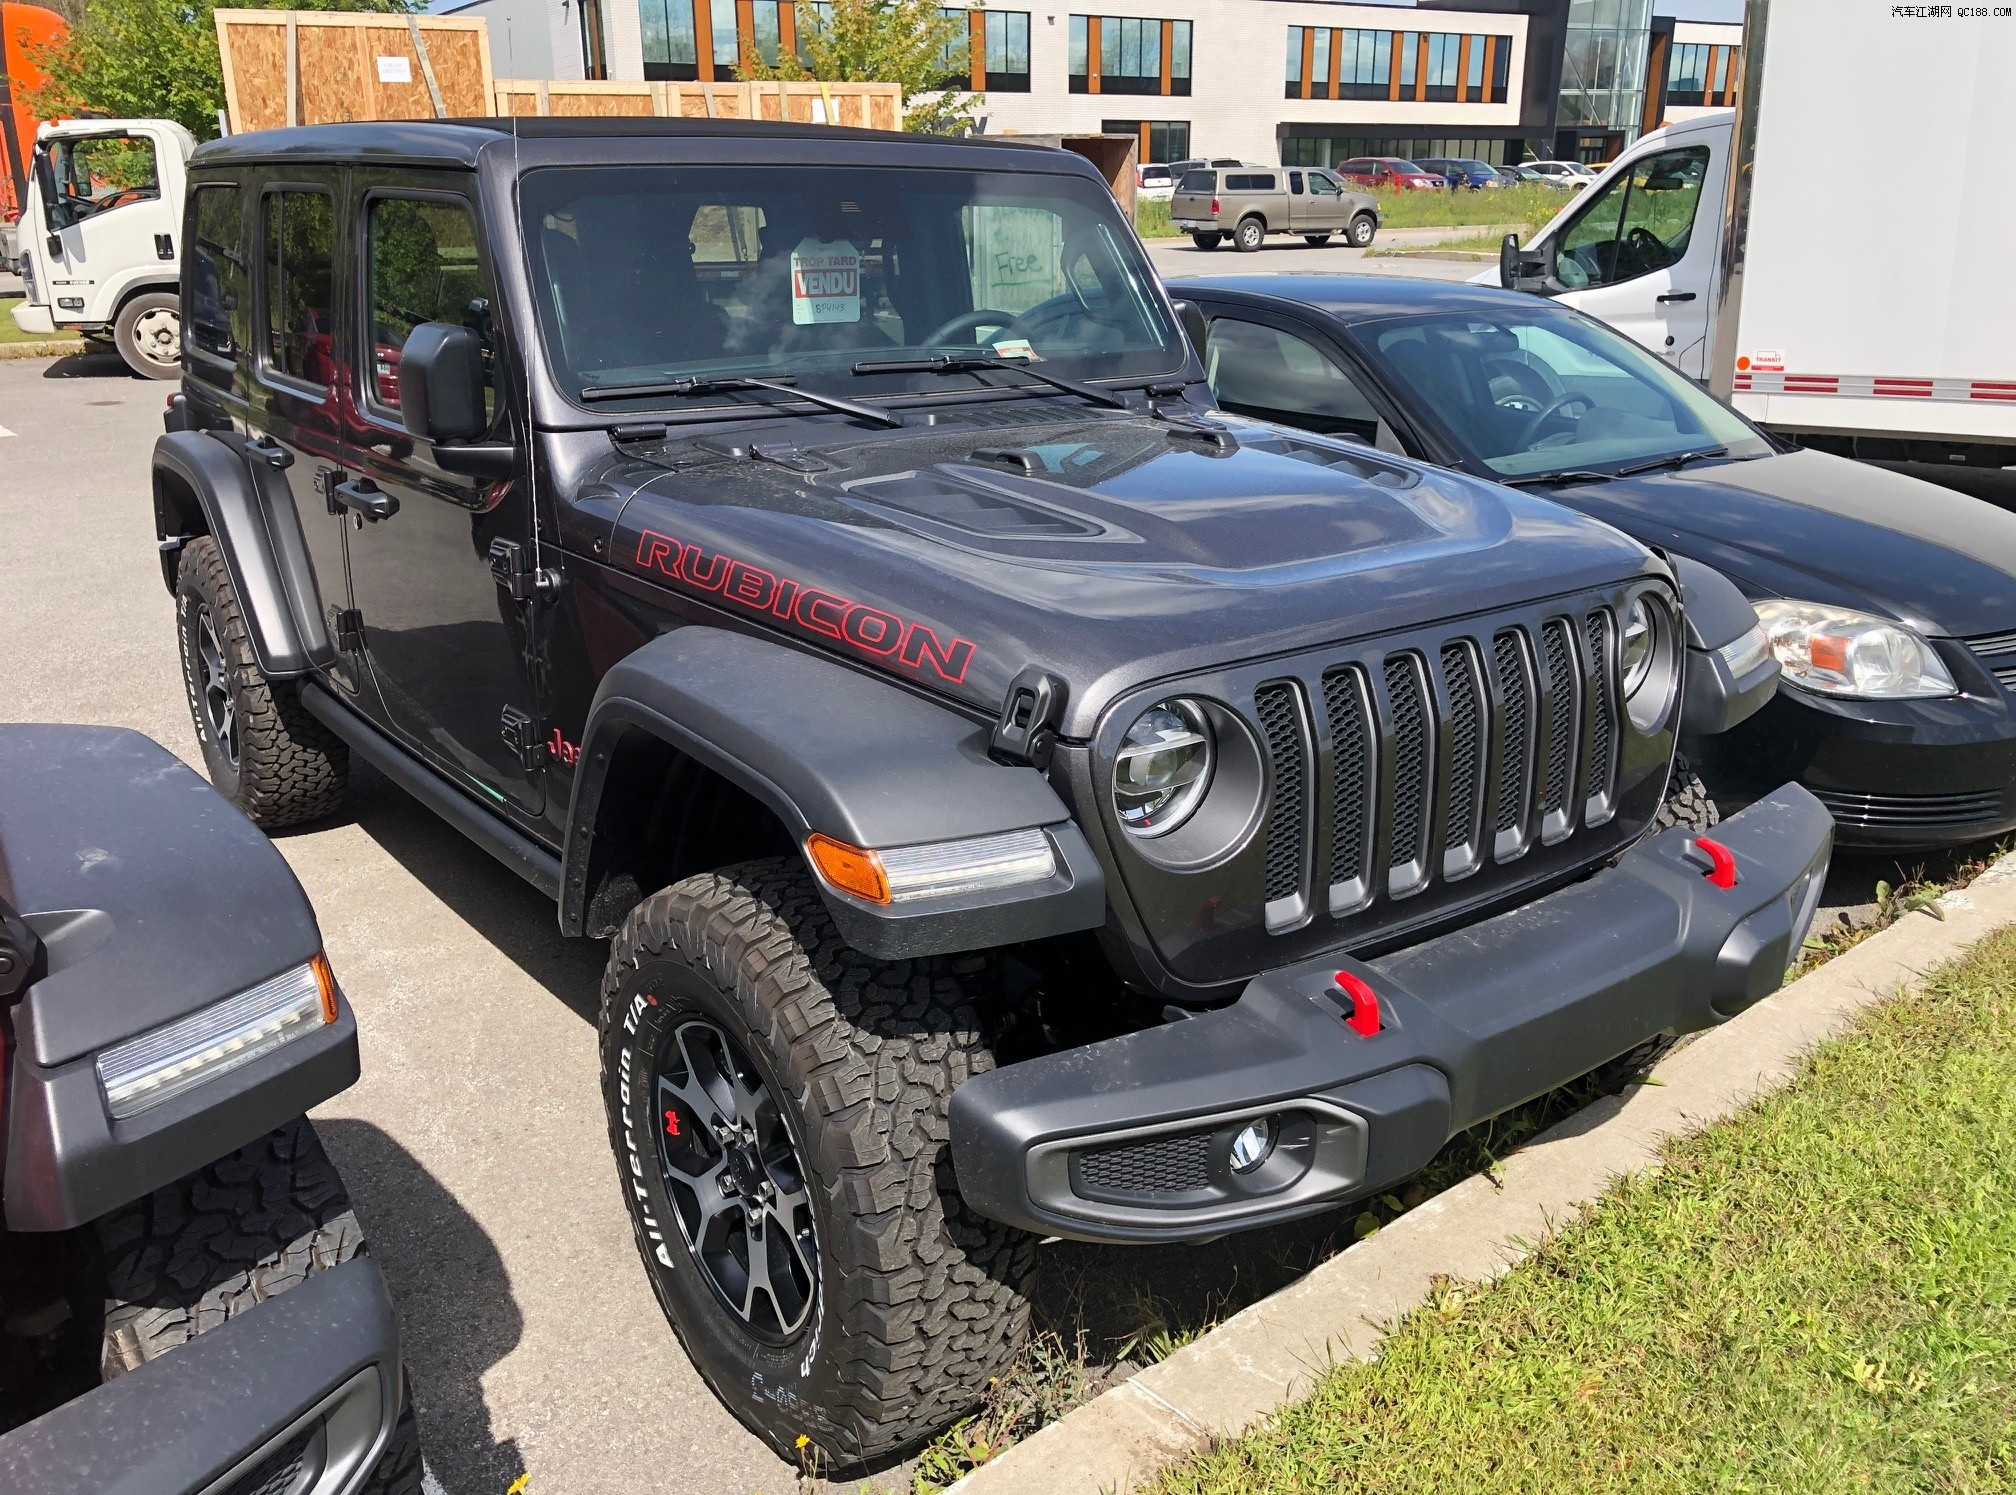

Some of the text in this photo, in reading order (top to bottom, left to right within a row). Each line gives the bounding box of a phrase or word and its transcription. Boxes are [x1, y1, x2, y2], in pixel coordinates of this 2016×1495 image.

[794, 256, 857, 267] TROP TARD
[995, 251, 1043, 282] Free
[797, 271, 855, 295] VENDU
[636, 529, 977, 684] RUBICON
[623, 993, 649, 1035] T/A
